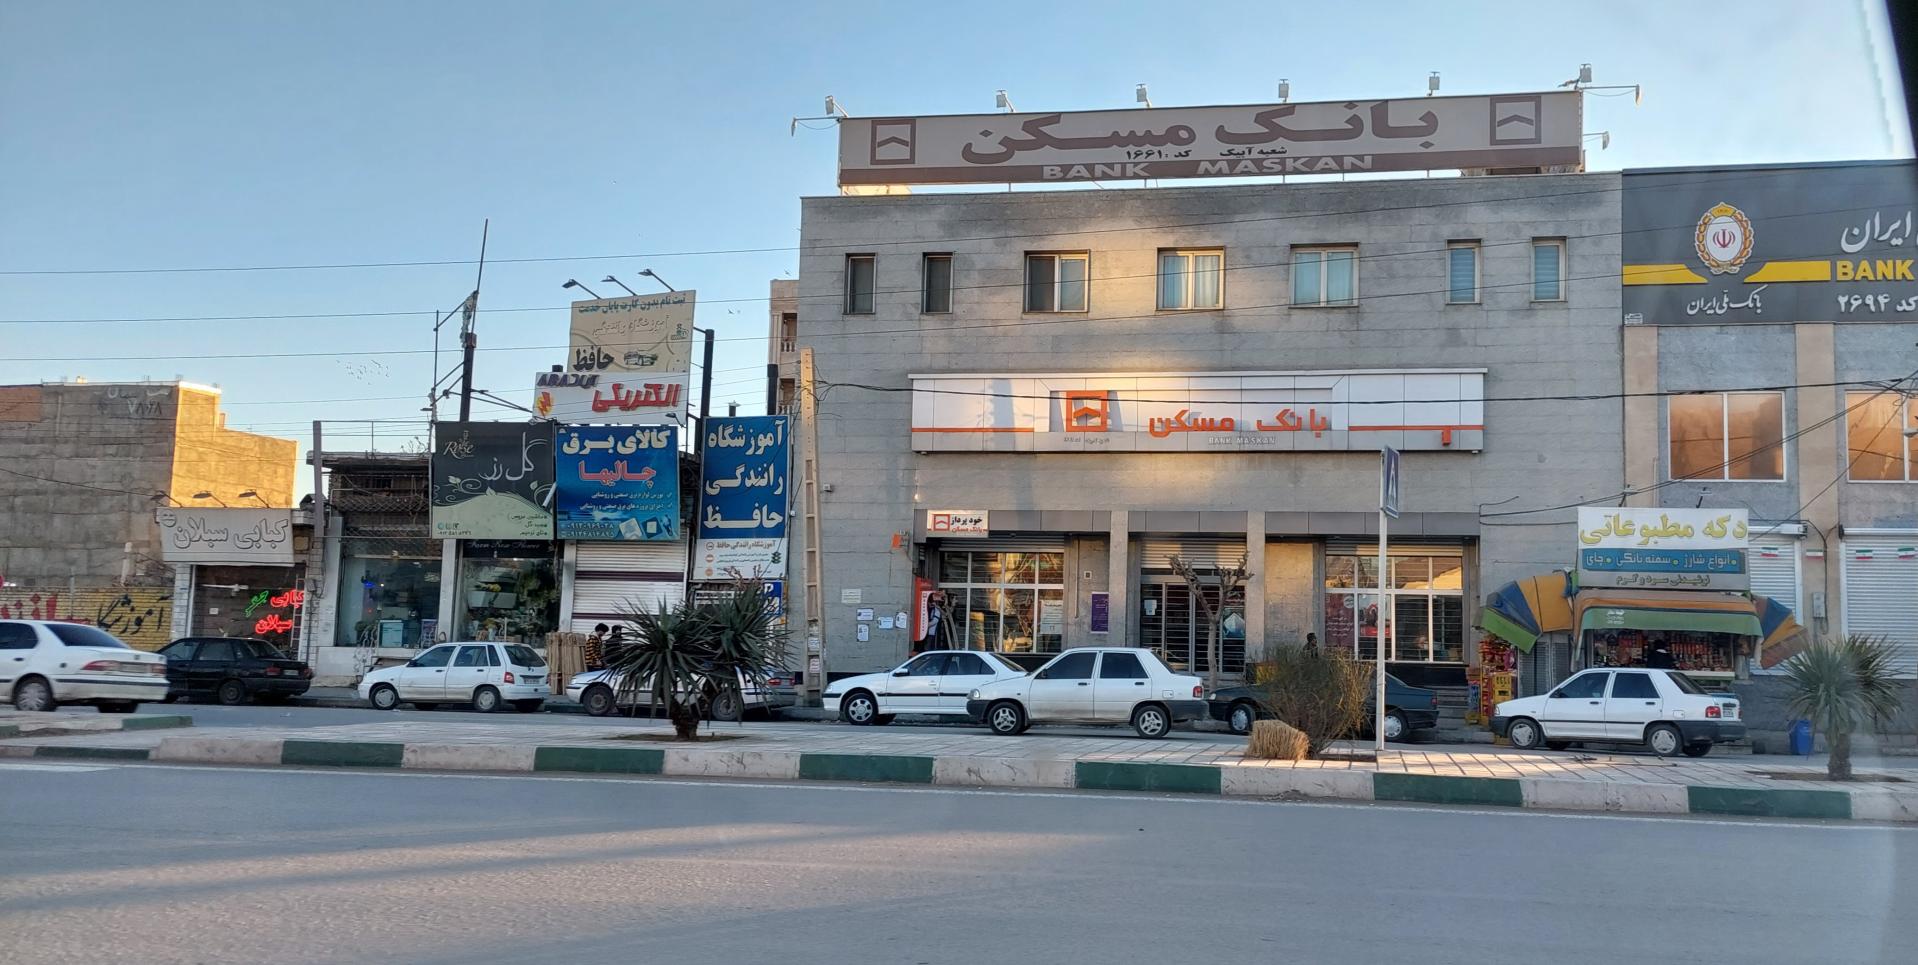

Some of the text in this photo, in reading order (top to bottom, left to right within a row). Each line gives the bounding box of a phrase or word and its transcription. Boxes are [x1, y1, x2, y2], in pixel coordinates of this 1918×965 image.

[962, 100, 1438, 164] بانک مسکن
[1174, 149, 1192, 158] کد
[1257, 146, 1288, 156] شعبه
[1042, 155, 1373, 180] BANK MASKAN
[1840, 210, 1912, 253] ایران
[1836, 259, 1915, 281] BANK
[640, 298, 659, 310] بدون
[660, 296, 671, 308] نام
[1686, 297, 1716, 315] ایران
[1730, 284, 1768, 313] بانک
[1837, 293, 1891, 313] ۲۶۹۴
[573, 346, 614, 371] حافظ
[1149, 408, 1327, 438] بانک مسکن
[563, 429, 671, 454] کالای برق
[708, 419, 784, 455] آموزشگاه
[1208, 437, 1276, 446] BANK MASKAN
[505, 431, 548, 480] گل
[705, 463, 783, 495] رانندگی
[704, 502, 783, 528] حافظ
[951, 516, 983, 526] خود پرداز
[173, 516, 289, 549] کبابی سبلان
[1683, 552, 1705, 568] شارژ
[1707, 553, 1730, 570] انواع
[270, 590, 305, 609] کبابی
[255, 613, 293, 634] سبلان
